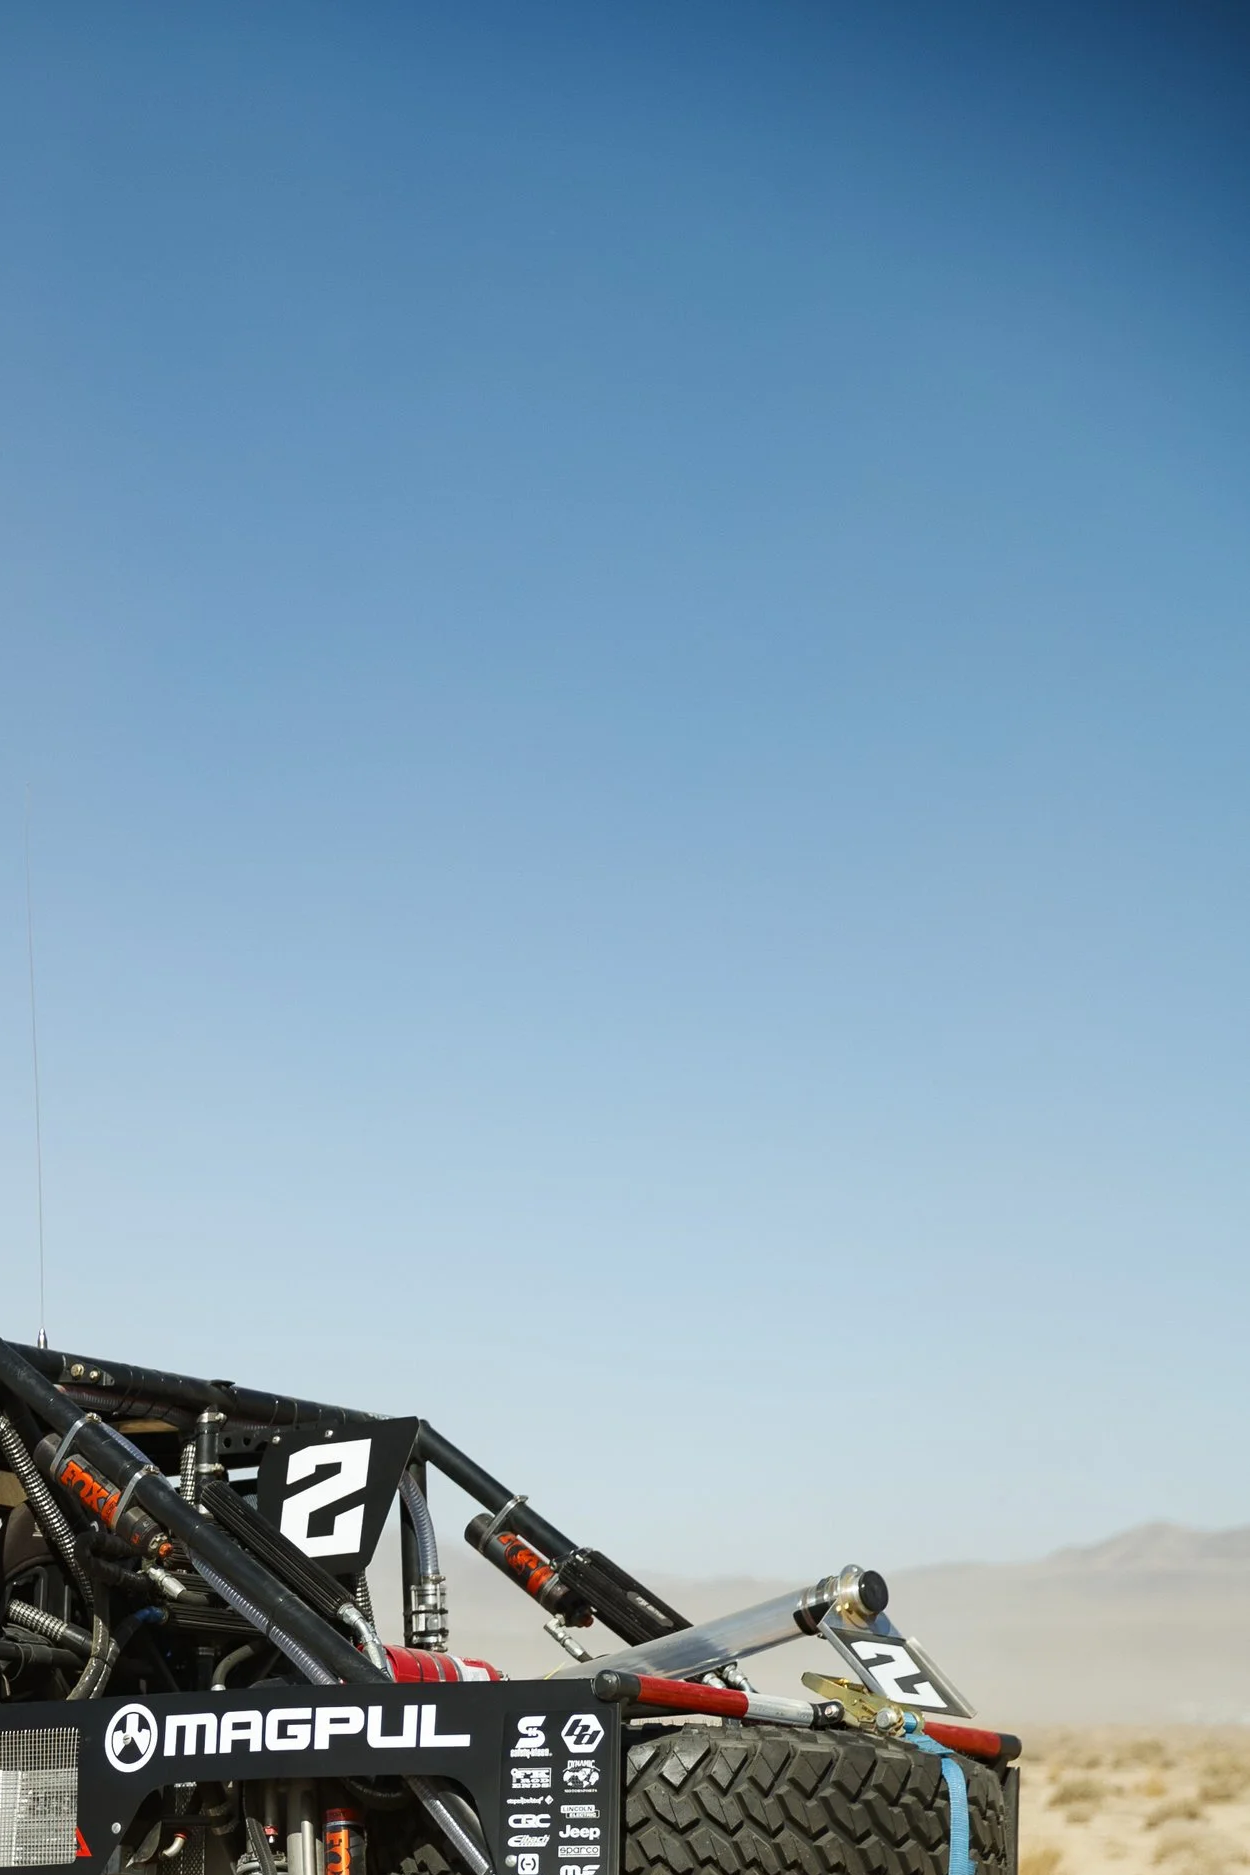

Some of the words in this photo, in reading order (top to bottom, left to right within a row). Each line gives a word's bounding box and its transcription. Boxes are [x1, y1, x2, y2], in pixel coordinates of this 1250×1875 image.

[60, 1460, 110, 1513] FOX
[280, 1438, 371, 1558] 2
[851, 1641, 948, 1708] 2
[163, 1704, 471, 1757] MAGPUL
[567, 1760, 595, 1769] DYNAMIC
[508, 1814, 551, 1828] CRC
[559, 1825, 600, 1840] Jeep
[508, 1835, 550, 1847] Eibach
[560, 1847, 599, 1855] sparco
